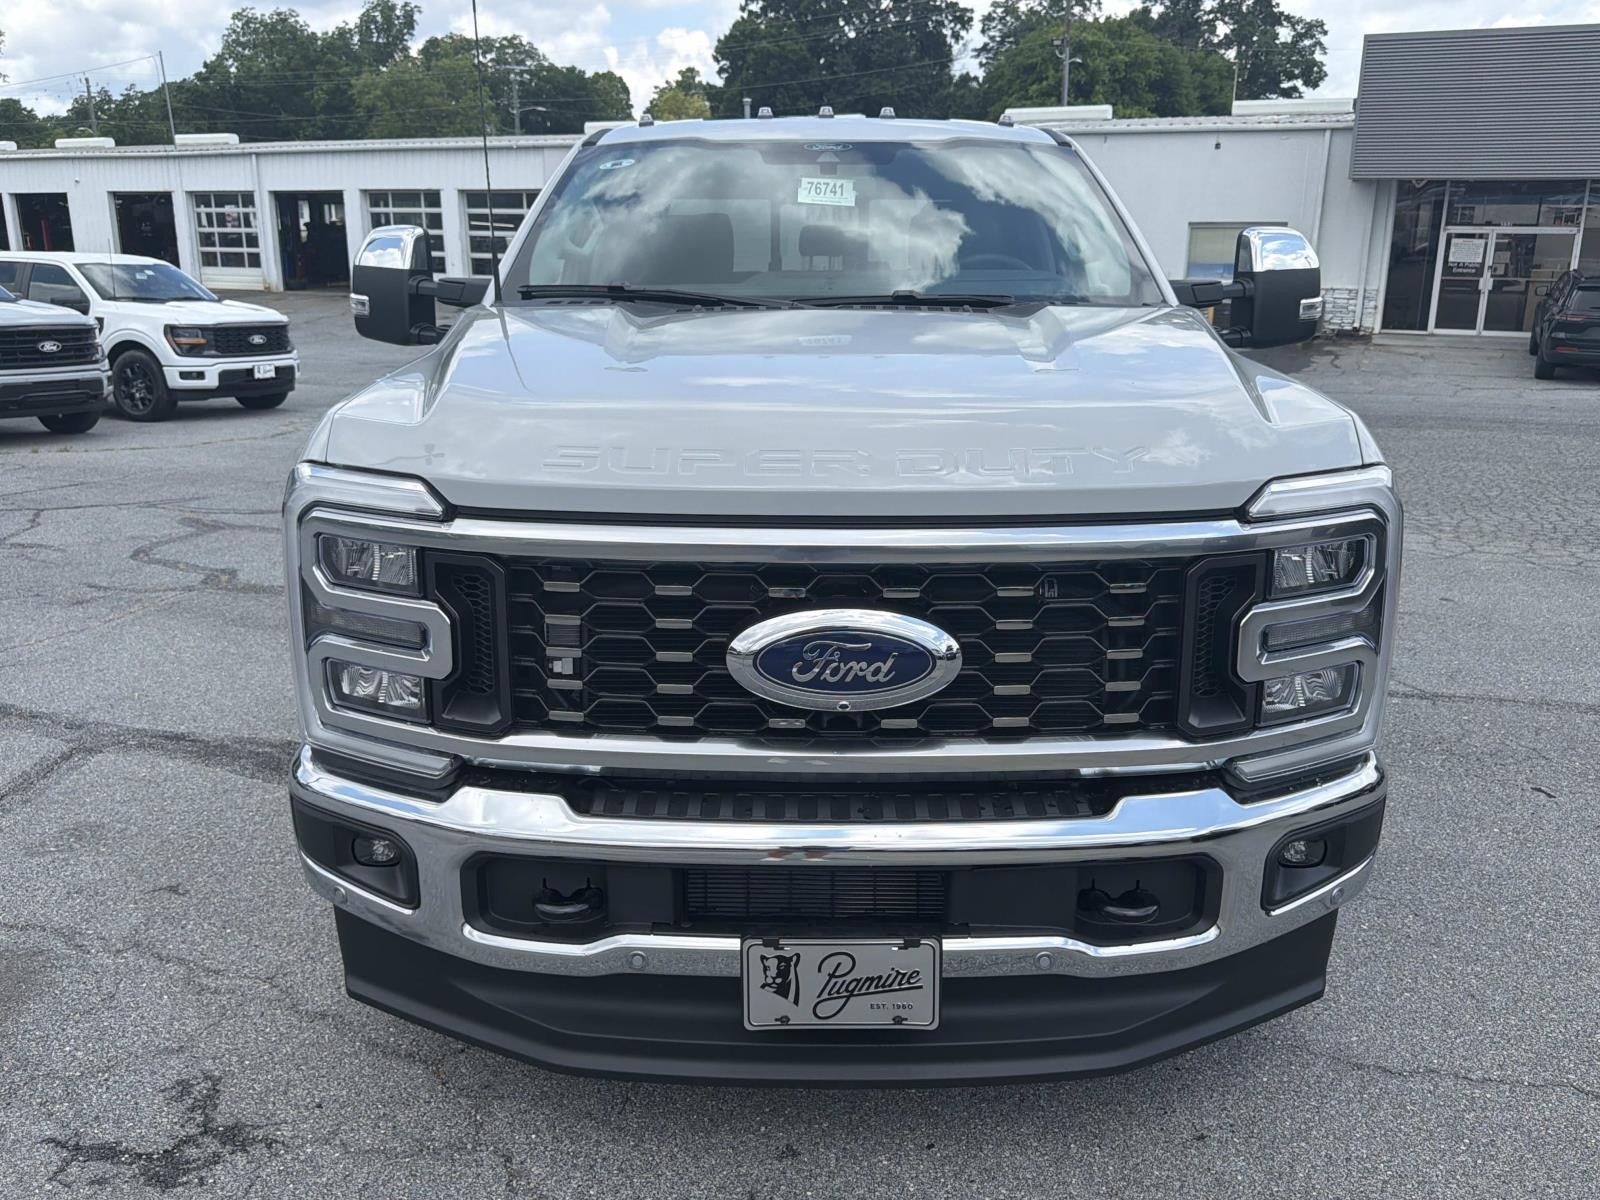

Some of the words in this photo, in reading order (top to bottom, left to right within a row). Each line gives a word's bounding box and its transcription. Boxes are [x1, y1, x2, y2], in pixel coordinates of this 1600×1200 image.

[807, 182, 844, 197] 76741
[541, 446, 869, 476] SUPER
[895, 447, 1148, 476] DUTY
[791, 640, 899, 682] Ford
[812, 951, 924, 1020] Pugmire
